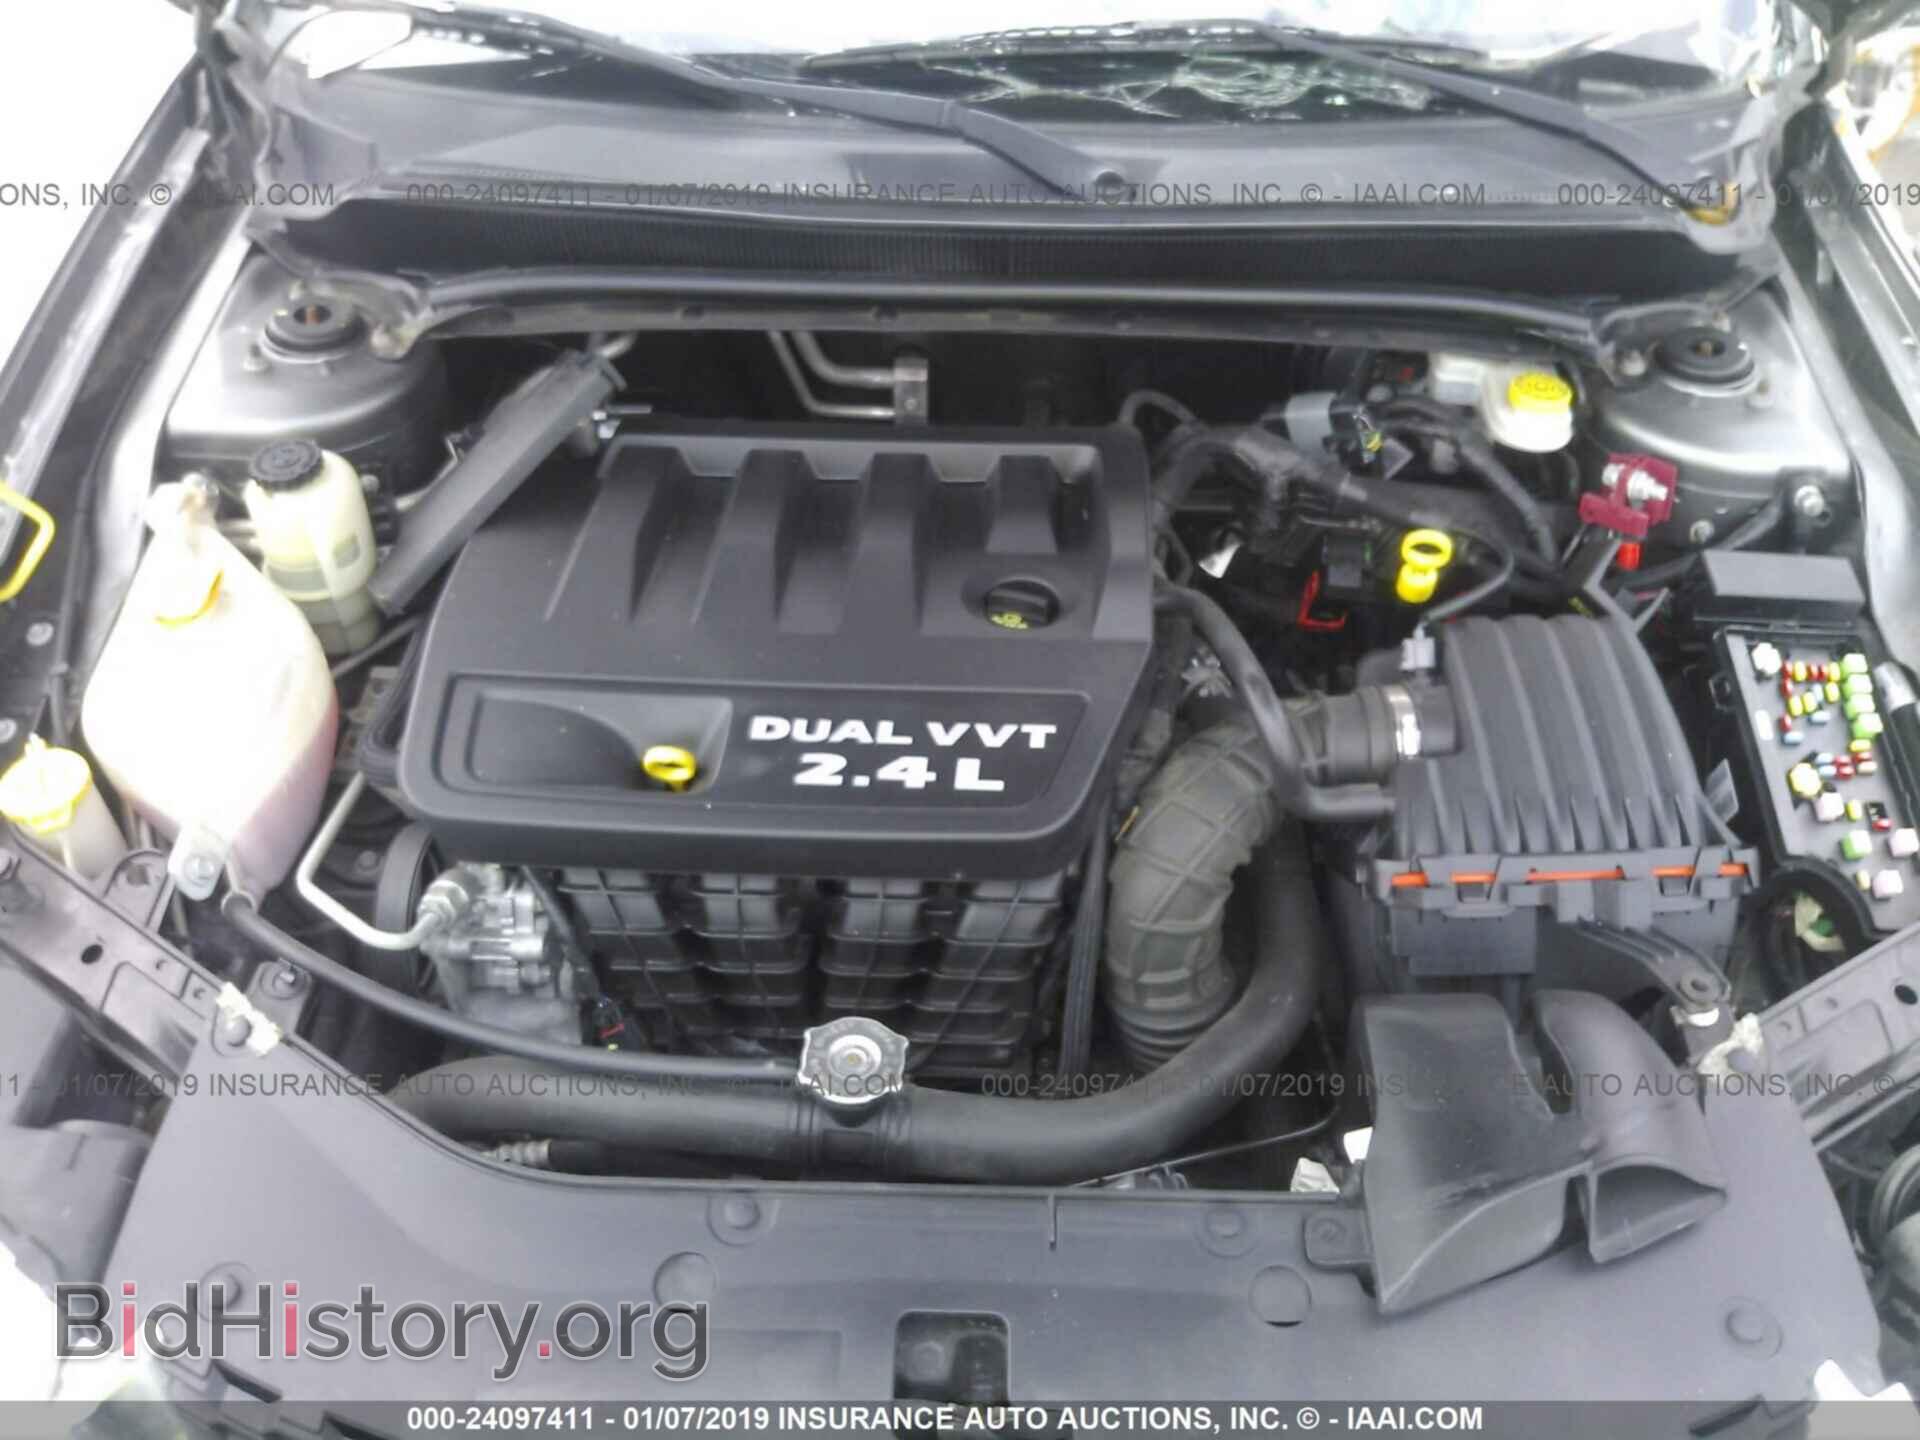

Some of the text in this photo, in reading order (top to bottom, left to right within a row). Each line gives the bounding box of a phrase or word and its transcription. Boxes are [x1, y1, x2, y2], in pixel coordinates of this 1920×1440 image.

[750, 716, 1057, 748] DUAL VVT
[793, 752, 1005, 791] 2.4 L
